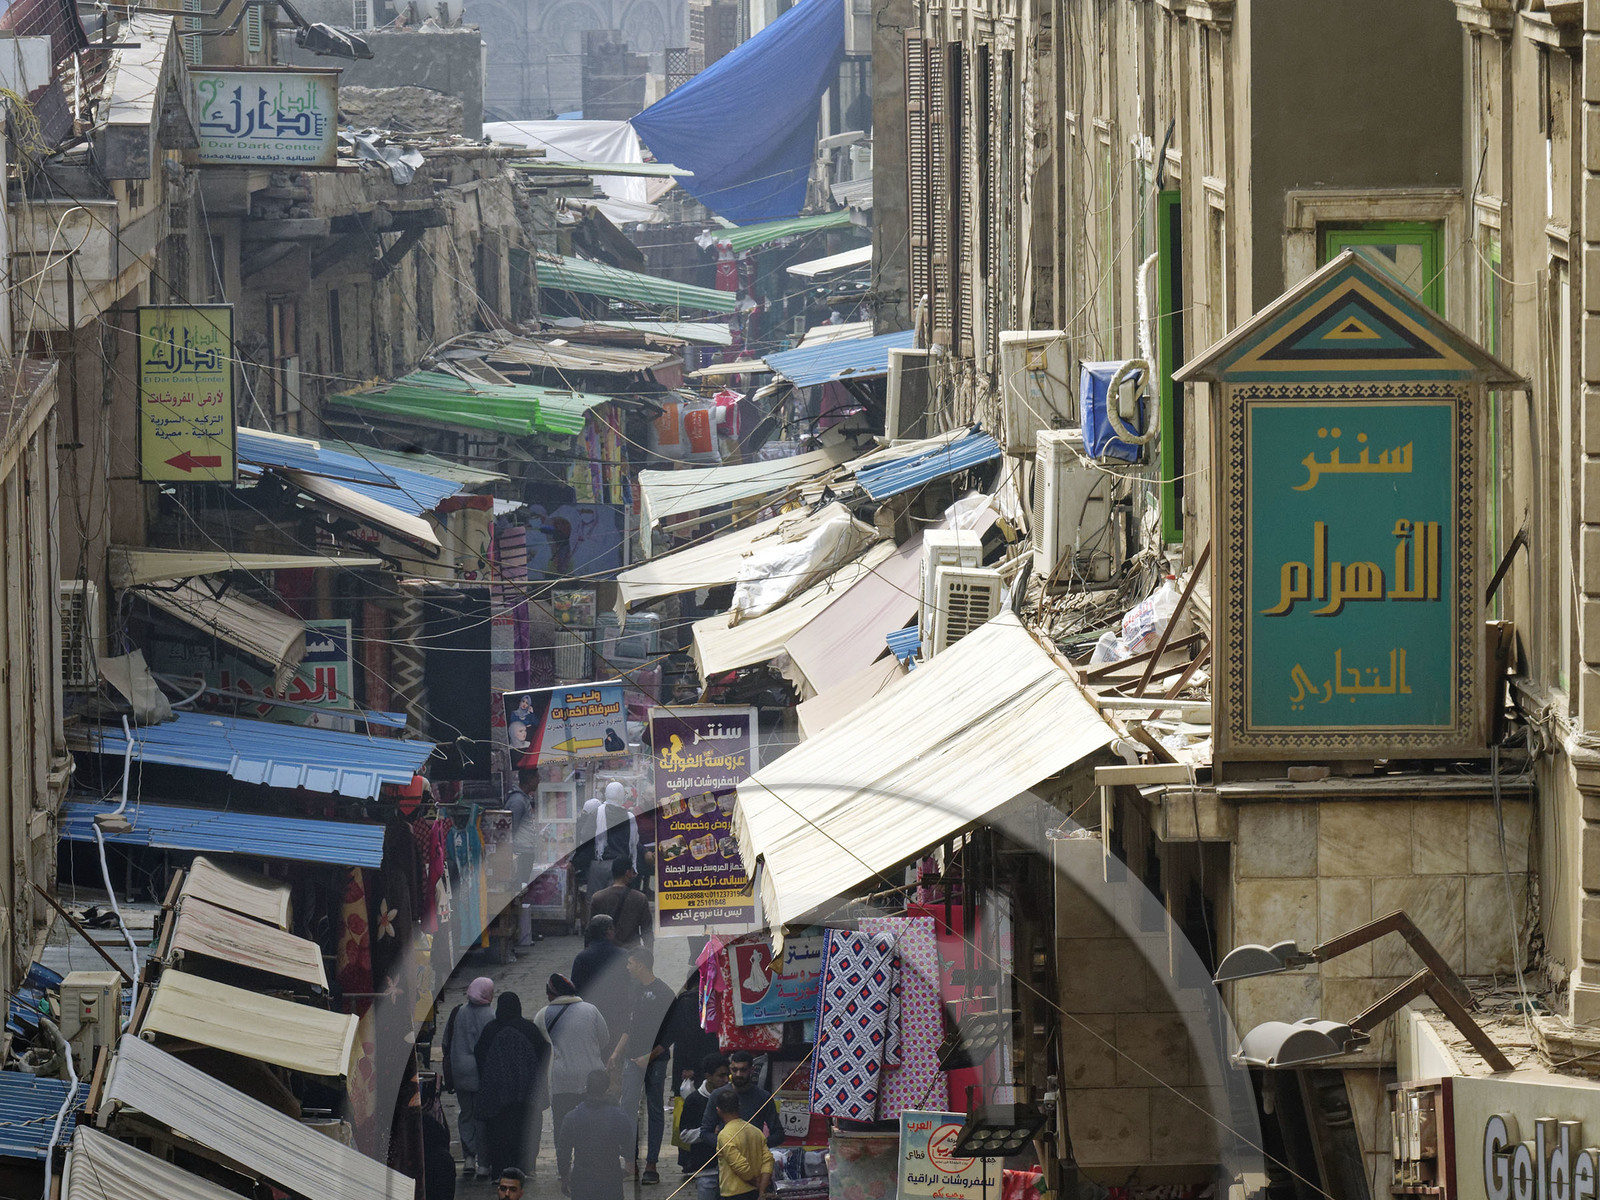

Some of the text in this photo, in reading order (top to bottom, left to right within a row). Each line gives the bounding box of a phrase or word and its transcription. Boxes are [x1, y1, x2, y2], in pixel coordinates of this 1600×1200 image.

[237, 141, 270, 149] Dark
[274, 142, 321, 151] Center
[154, 376, 170, 384] Dar
[172, 376, 193, 384] Dark
[196, 376, 226, 384] Center
[148, 392, 194, 408] المفروشات
[1291, 427, 1414, 492] سنتر
[1258, 518, 1442, 617] الأهرام
[1289, 647, 1413, 711] التجاري
[551, 706, 587, 721] الخمارات
[692, 723, 742, 745] سنتر
[711, 820, 731, 831] روض
[713, 909, 722, 917] لنا
[724, 908, 742, 918] ليس
[784, 944, 820, 964] سنتر
[907, 1120, 932, 1133] العرب
[908, 1173, 995, 1188] للمفروشات الراقية
